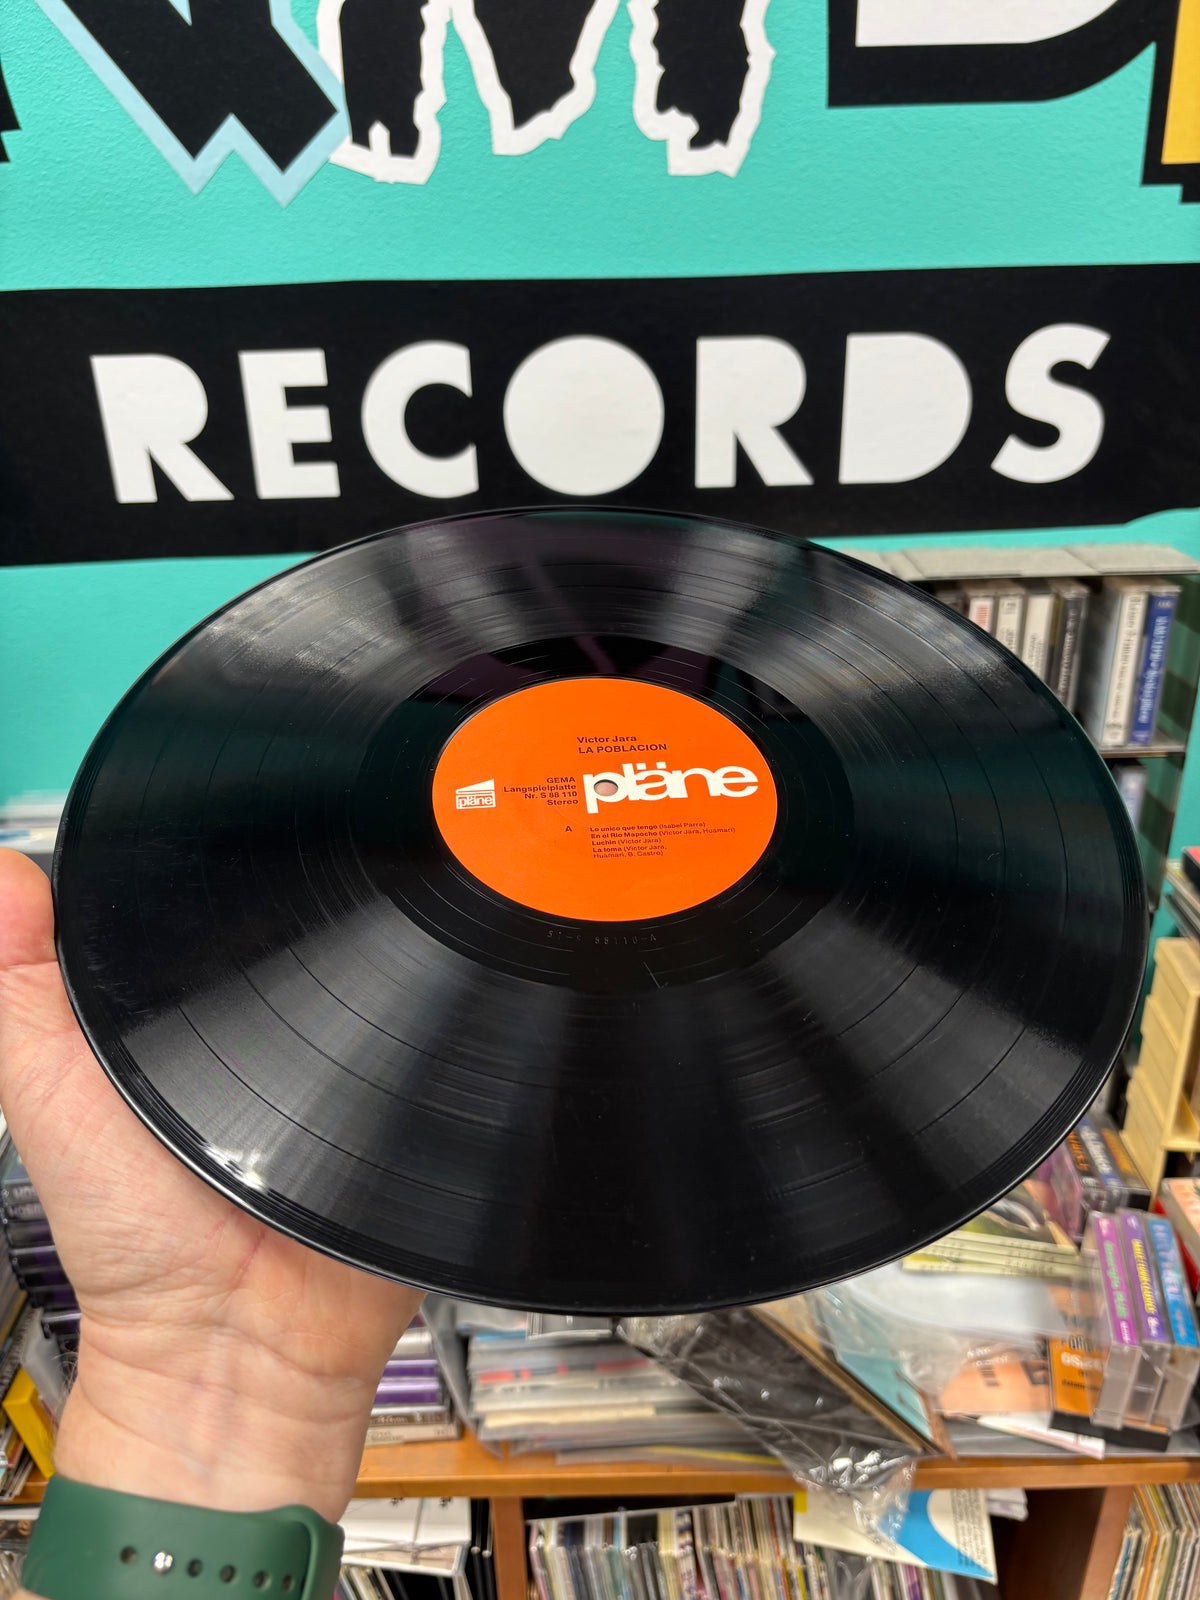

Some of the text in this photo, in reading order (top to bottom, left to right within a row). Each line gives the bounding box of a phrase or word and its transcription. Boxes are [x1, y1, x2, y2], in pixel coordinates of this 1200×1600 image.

[91, 323, 1110, 503] RECORDS
[576, 735, 610, 744] Victor
[596, 743, 668, 753] POBLACION
[503, 784, 577, 793] Langspielplatte
[583, 762, 758, 813] pläne
[561, 790, 578, 798] 110
[459, 795, 493, 807] pläne
